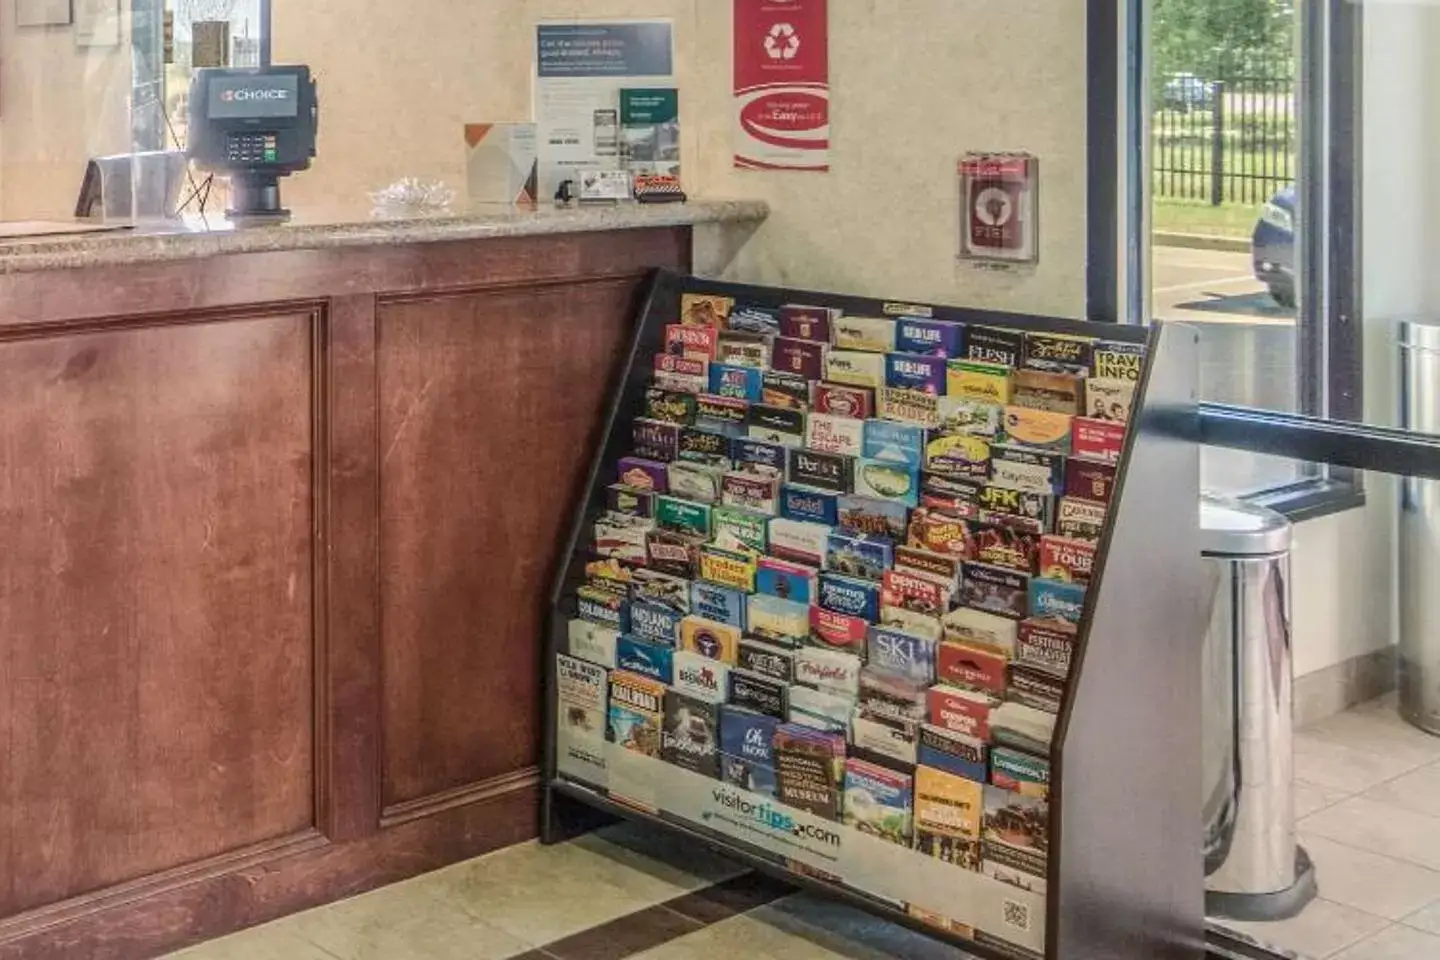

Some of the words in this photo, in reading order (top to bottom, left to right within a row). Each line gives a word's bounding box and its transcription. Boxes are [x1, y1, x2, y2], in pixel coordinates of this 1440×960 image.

[234, 89, 289, 101] CHOICE
[1098, 352, 1142, 366] TRAV
[1099, 367, 1139, 381] INFO
[812, 420, 833, 432] THE
[811, 431, 852, 447] ESCAPE
[980, 488, 1019, 507] JFK
[1052, 549, 1093, 568] TOUR
[877, 634, 914, 660] SKI
